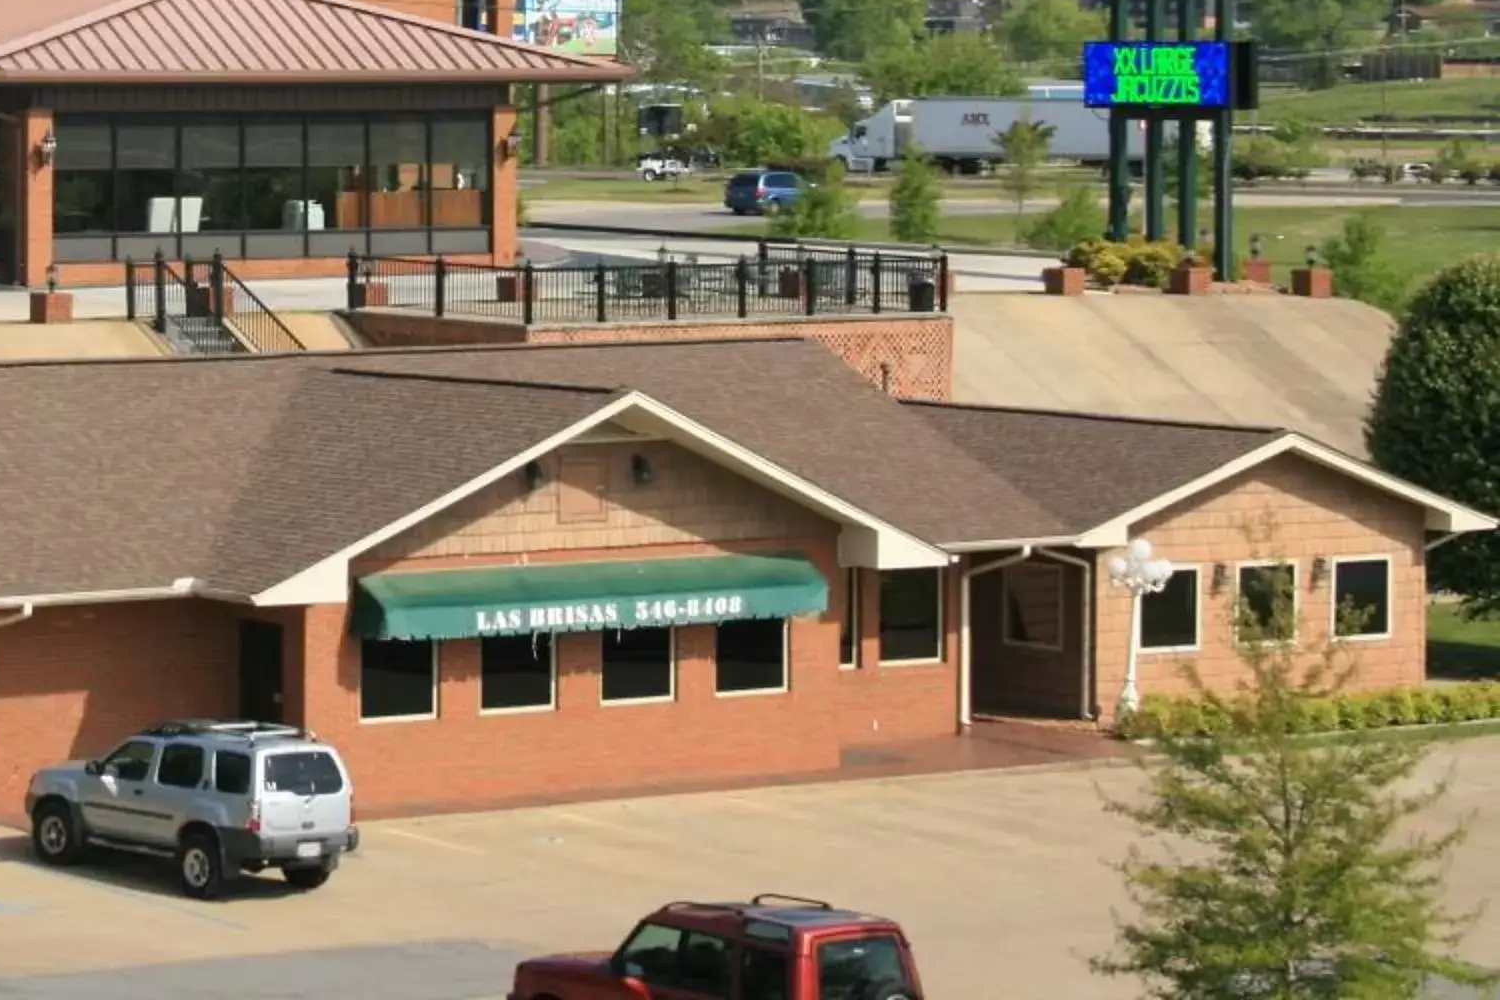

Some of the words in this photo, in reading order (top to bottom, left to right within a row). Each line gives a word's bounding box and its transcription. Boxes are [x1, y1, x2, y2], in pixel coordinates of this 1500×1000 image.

[1113, 46, 1138, 75] XX
[1140, 46, 1197, 75] LARGE
[1109, 75, 1200, 103] JACUZZIS
[475, 609, 521, 631] LAS
[529, 603, 618, 628] BRISAS
